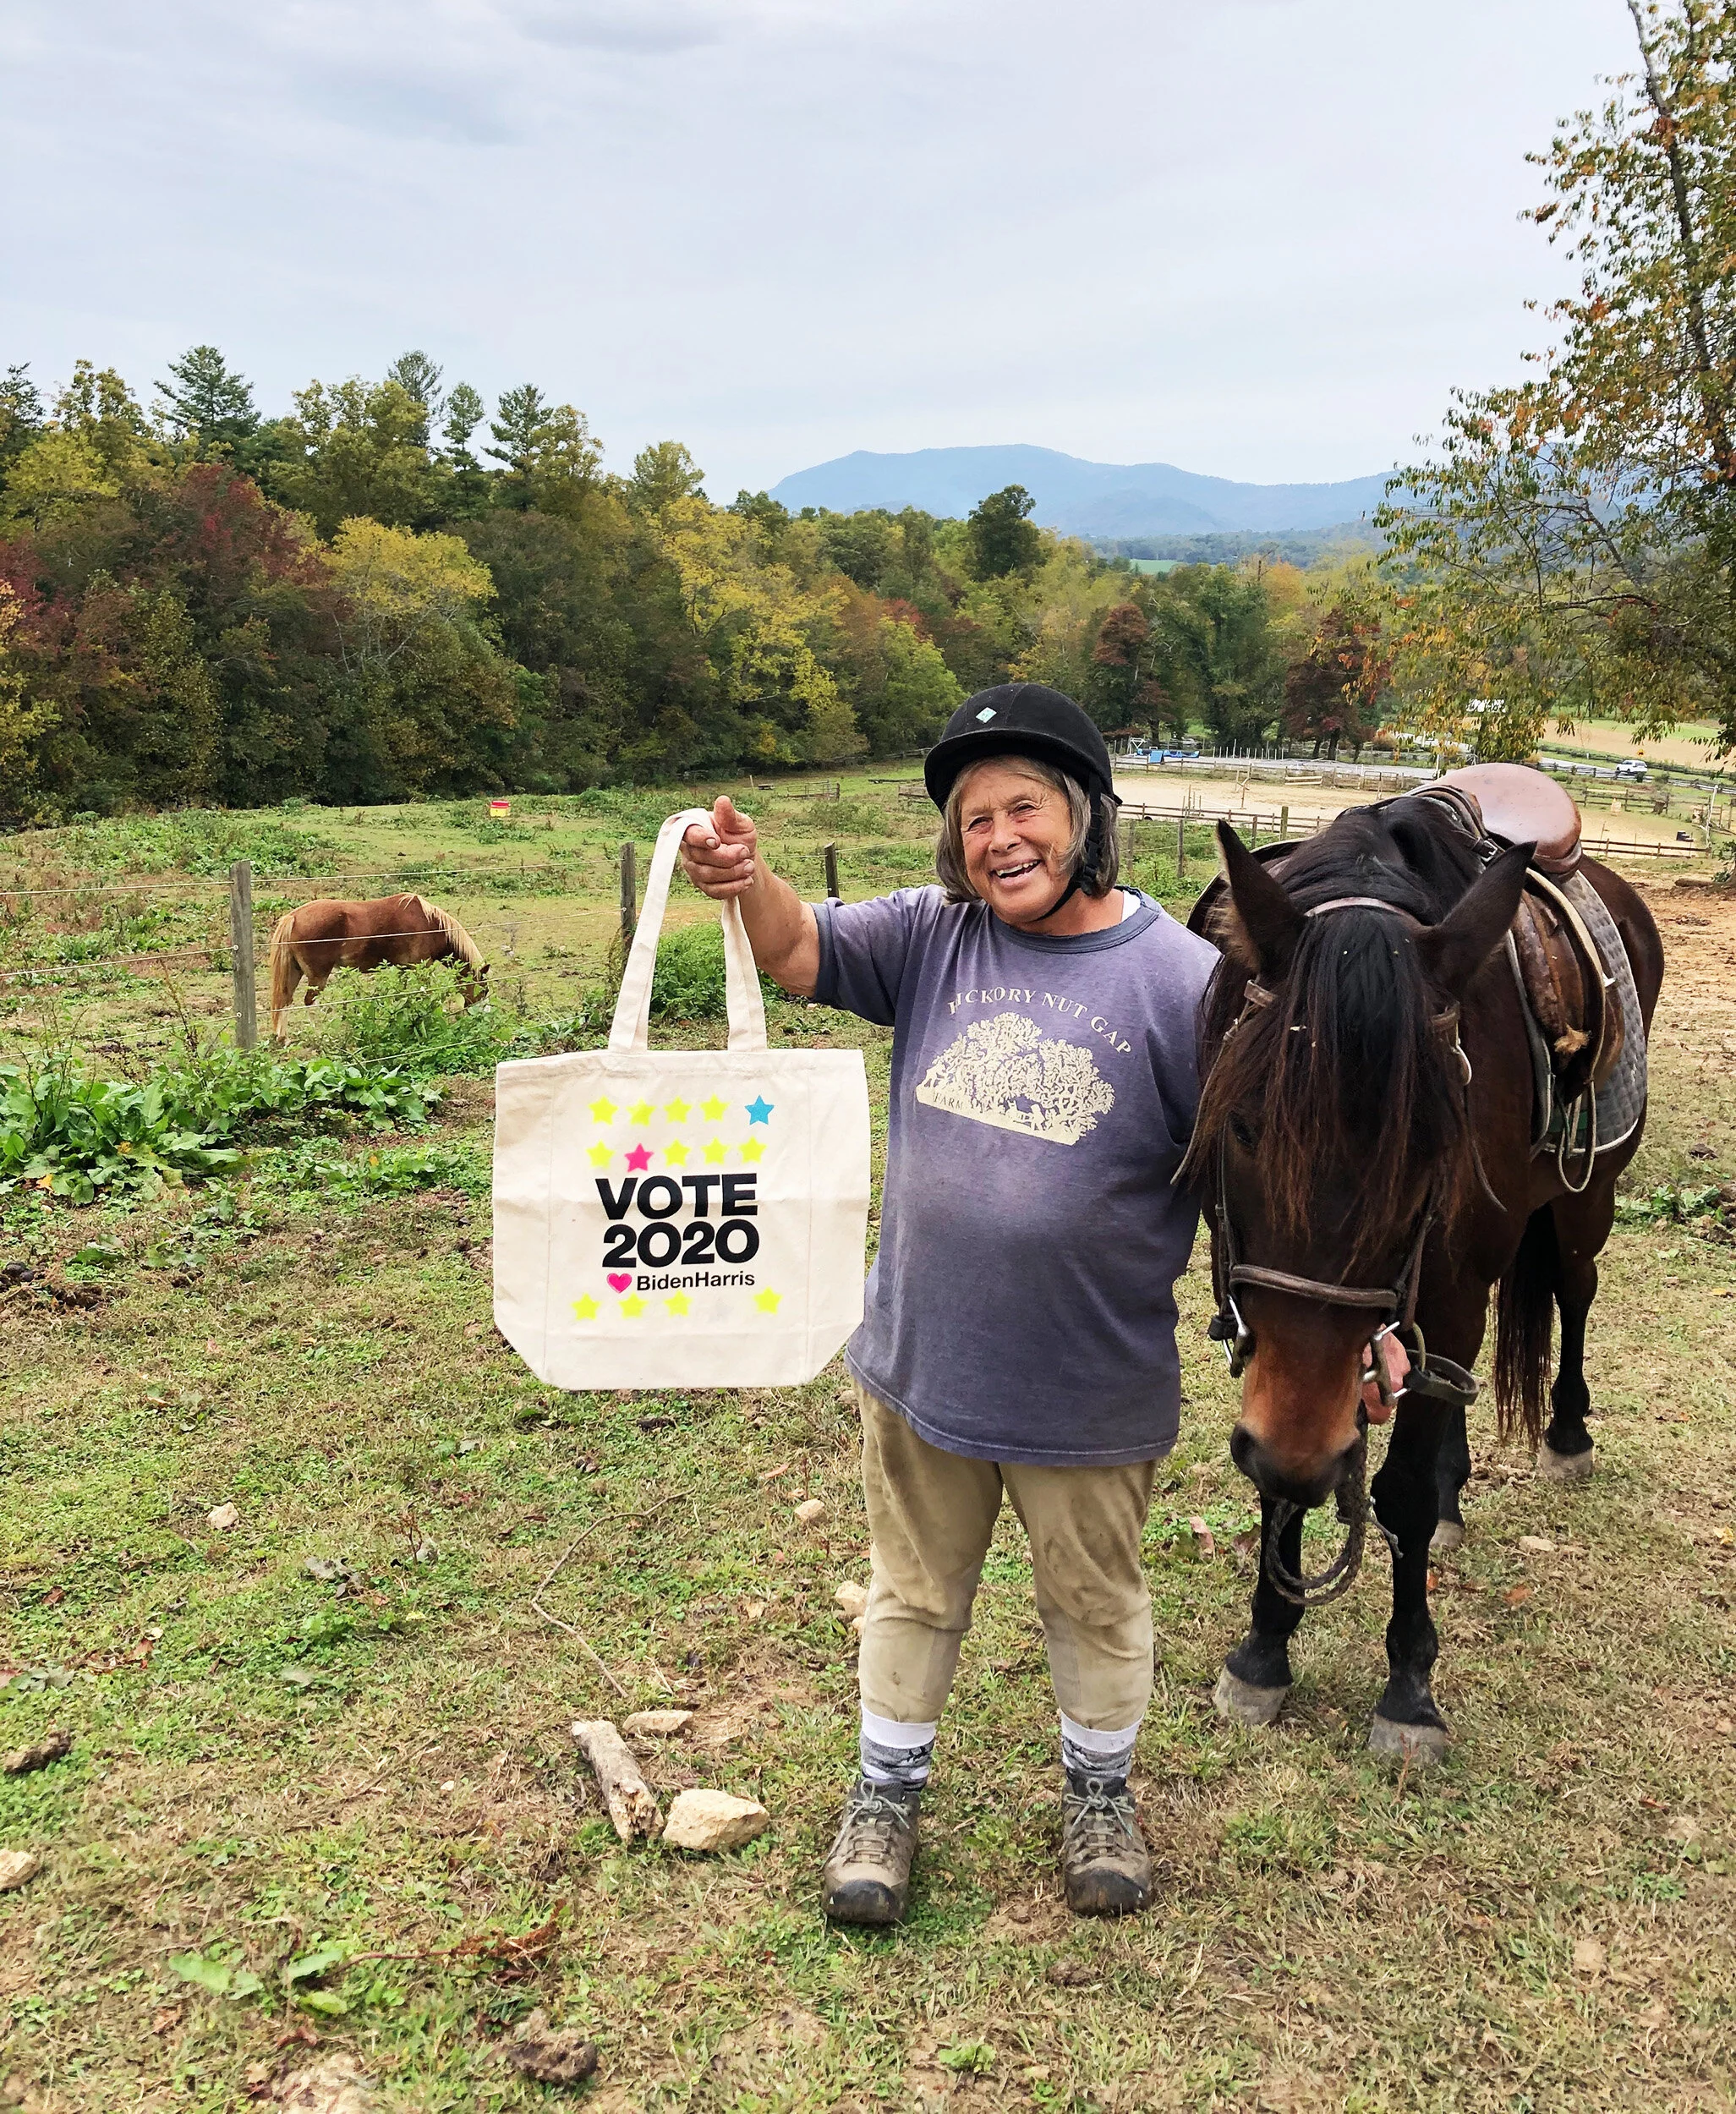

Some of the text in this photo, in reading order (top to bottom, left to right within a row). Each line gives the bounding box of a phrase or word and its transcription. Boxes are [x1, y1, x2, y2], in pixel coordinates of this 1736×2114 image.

[948, 987, 1131, 1054] HICKORY NUT GAP
[933, 1092, 964, 1110] FARM
[595, 1173, 758, 1220] VOTE
[602, 1219, 760, 1268] 2020
[637, 1271, 755, 1291] BidenHarris
